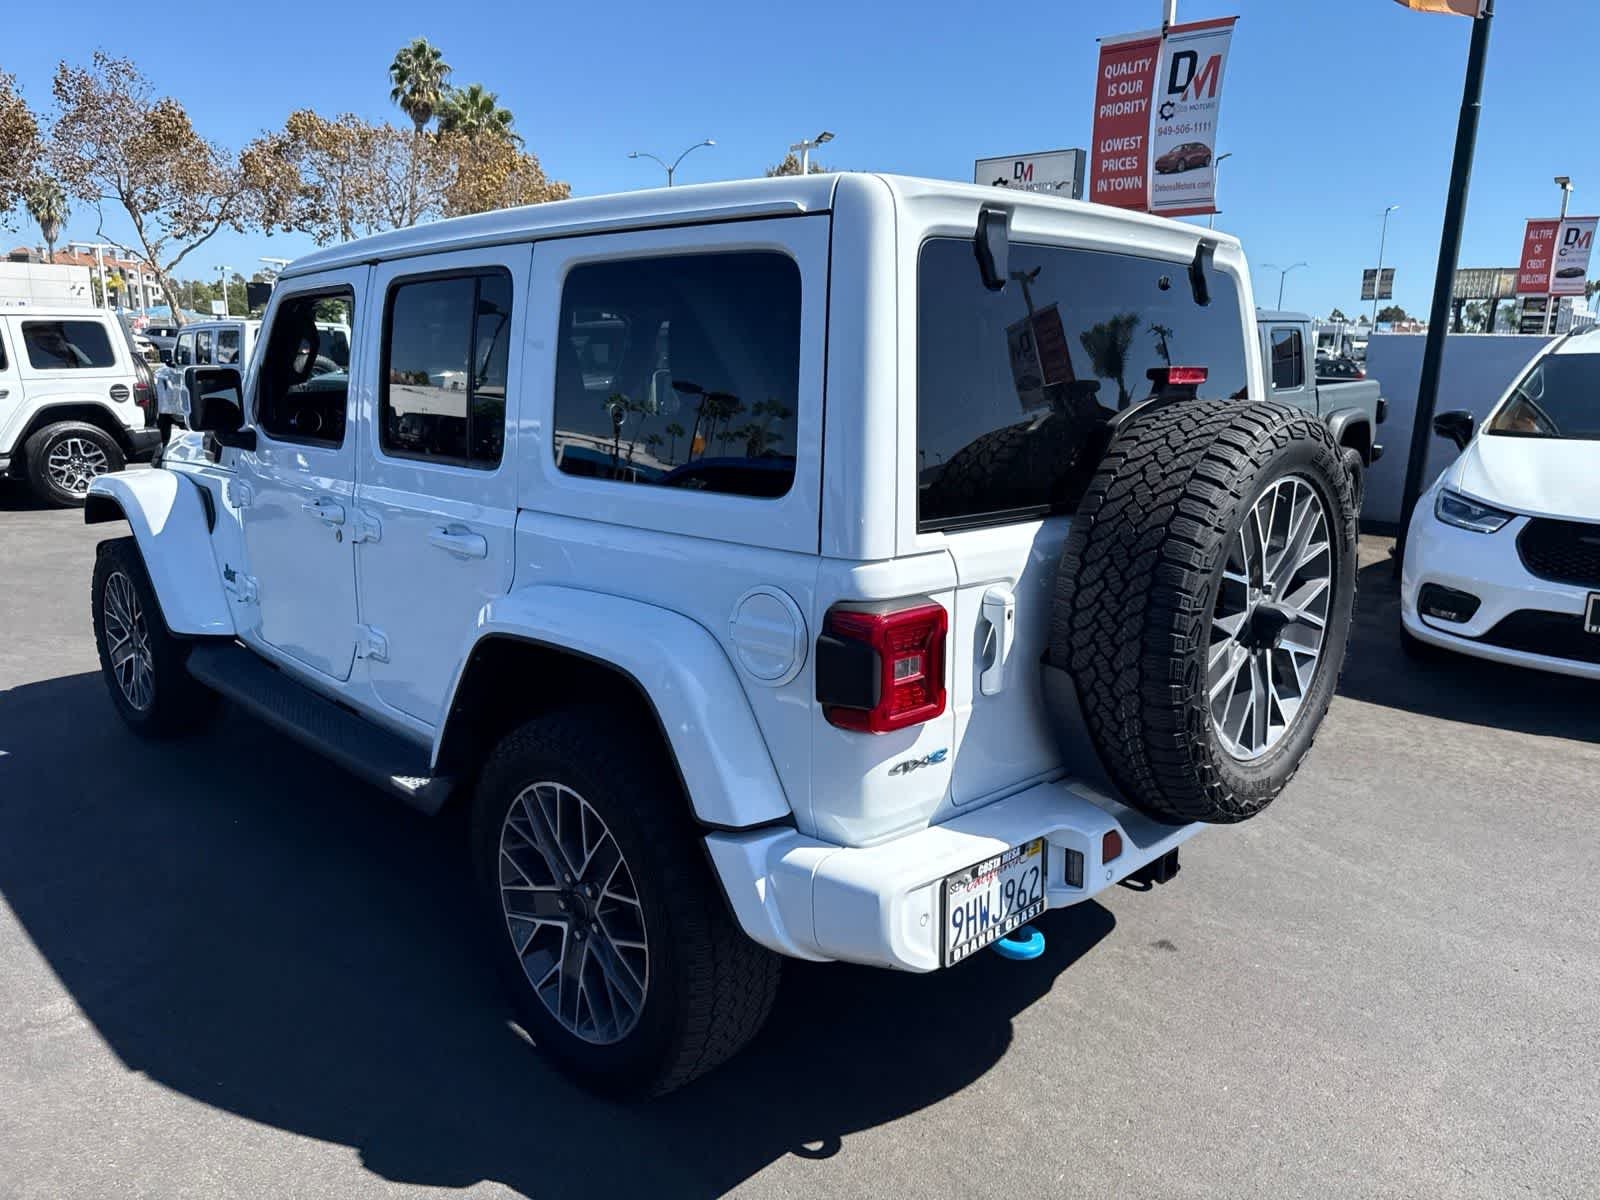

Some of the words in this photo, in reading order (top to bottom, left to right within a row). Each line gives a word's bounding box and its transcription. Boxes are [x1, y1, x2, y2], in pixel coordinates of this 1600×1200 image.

[1104, 58, 1152, 78] QUALITY
[1107, 83, 1117, 97] IS
[1119, 80, 1143, 94] OUR
[1100, 98, 1148, 119] PRIORITY
[1100, 136, 1143, 153] LOWEST
[1102, 157, 1138, 173] PRICES
[1097, 181, 1109, 193] IN
[1110, 176, 1143, 192] TOWN
[1534, 244, 1543, 254] OF
[951, 865, 1039, 948] 9HWJ962
[953, 923, 1001, 961] ORANGE
[1005, 901, 1042, 931] COAST
